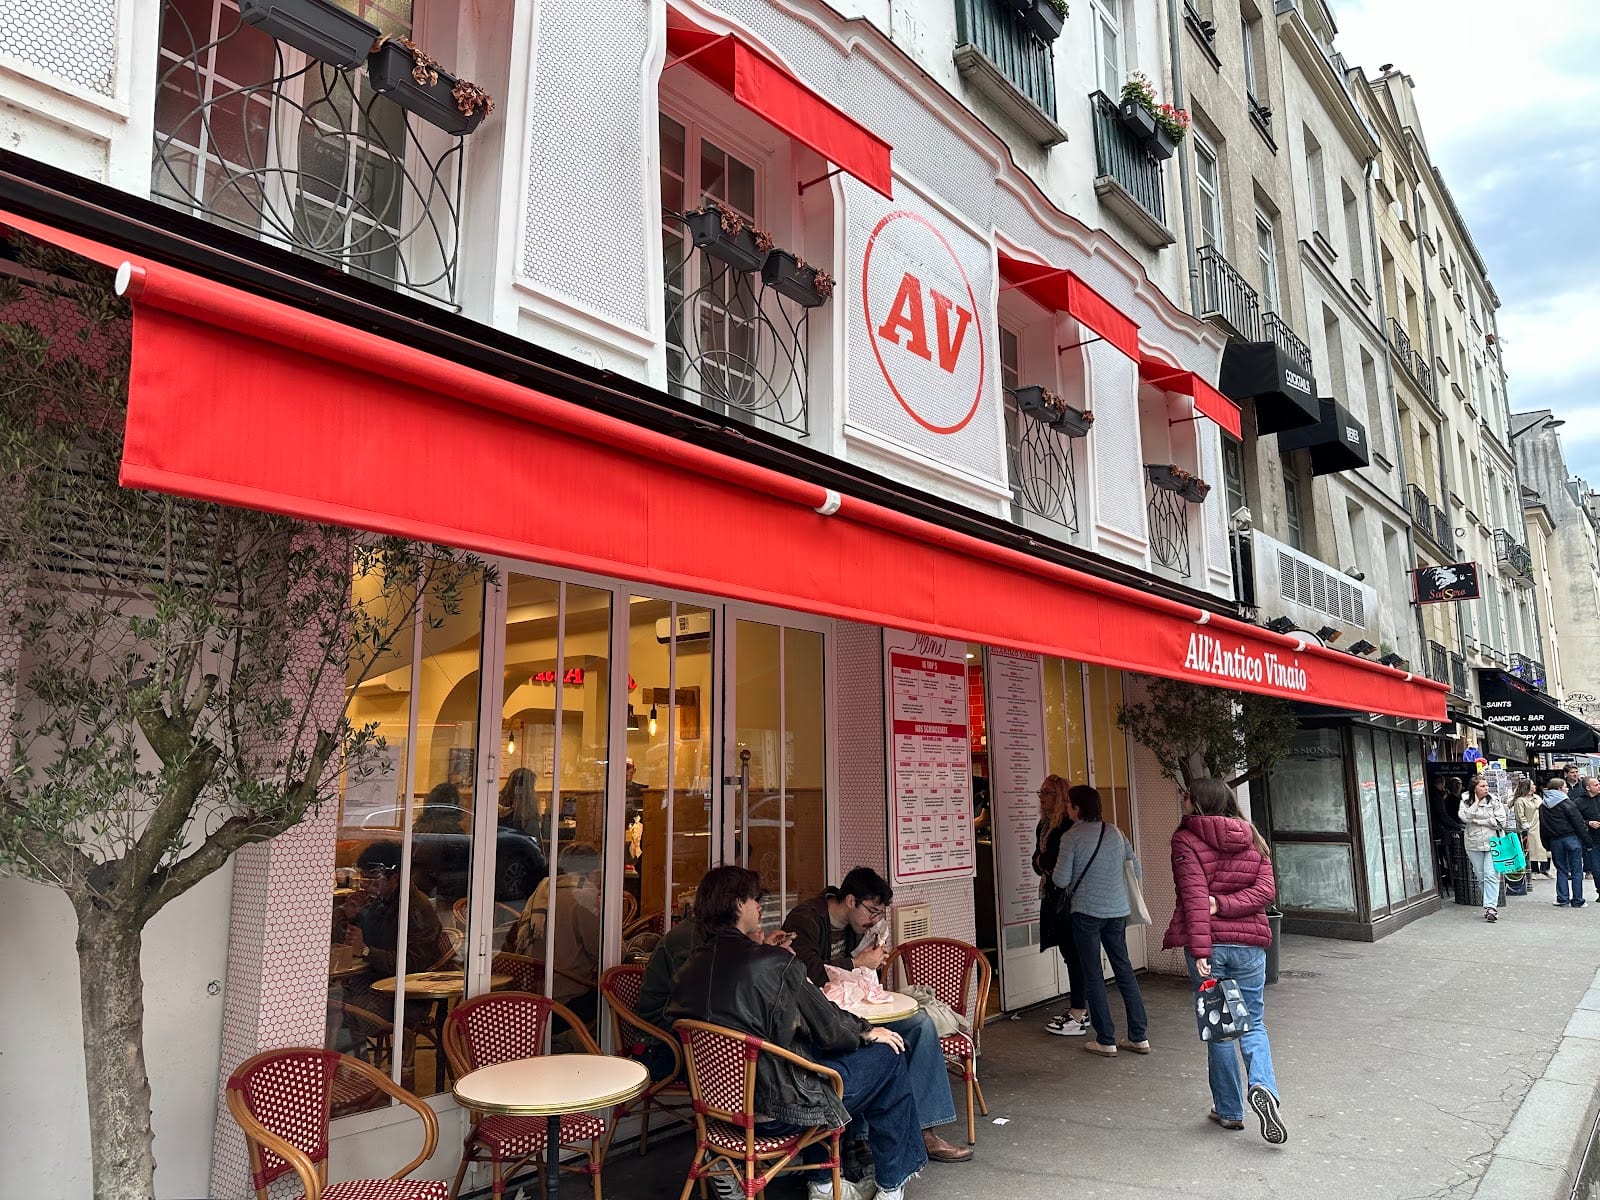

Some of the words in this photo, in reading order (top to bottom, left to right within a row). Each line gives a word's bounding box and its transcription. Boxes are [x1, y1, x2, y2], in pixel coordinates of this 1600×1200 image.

[878, 271, 972, 374] AV
[1184, 632, 1263, 683] All'Antico
[1263, 652, 1307, 692] Vinaio
